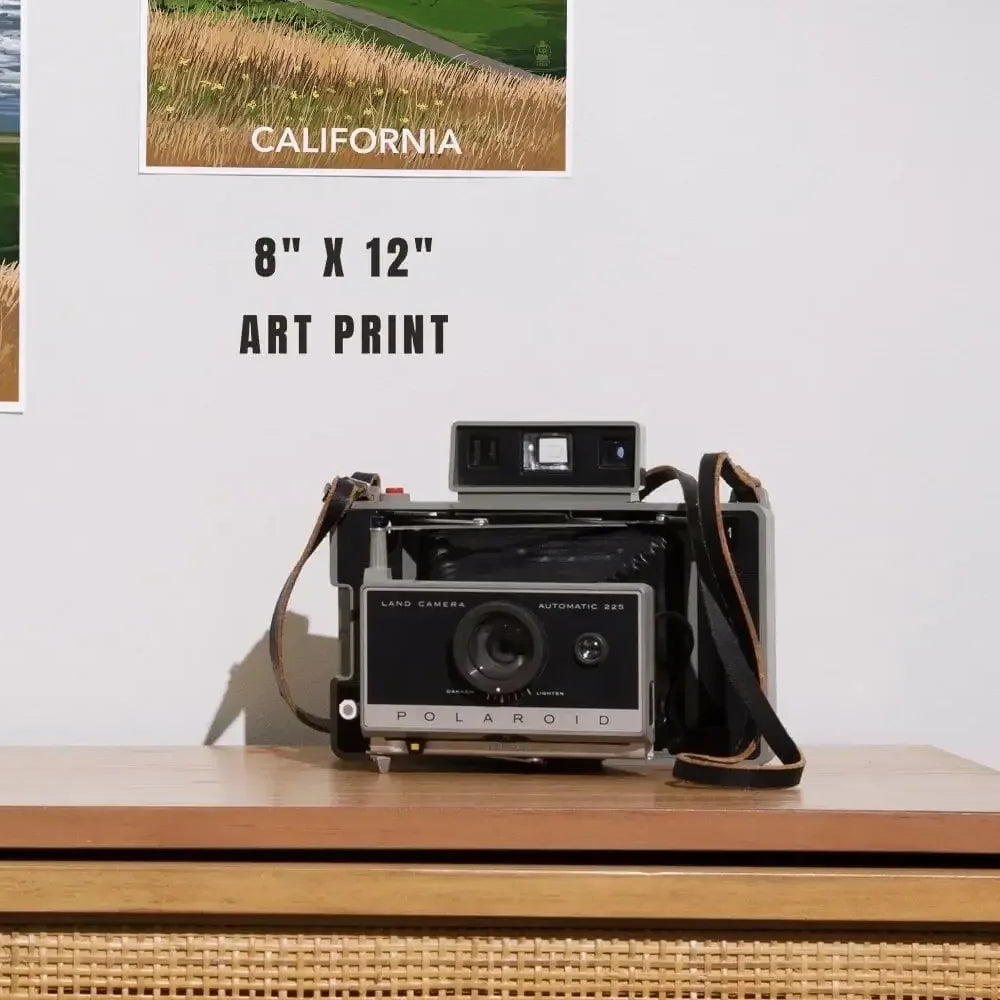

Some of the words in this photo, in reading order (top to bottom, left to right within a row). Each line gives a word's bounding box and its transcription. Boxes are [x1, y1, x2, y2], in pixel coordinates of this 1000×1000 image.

[251, 125, 463, 155] CALIFORNIA
[381, 600, 412, 608] LAND
[418, 600, 466, 609] CAMERA
[396, 710, 610, 726] POLAROID
